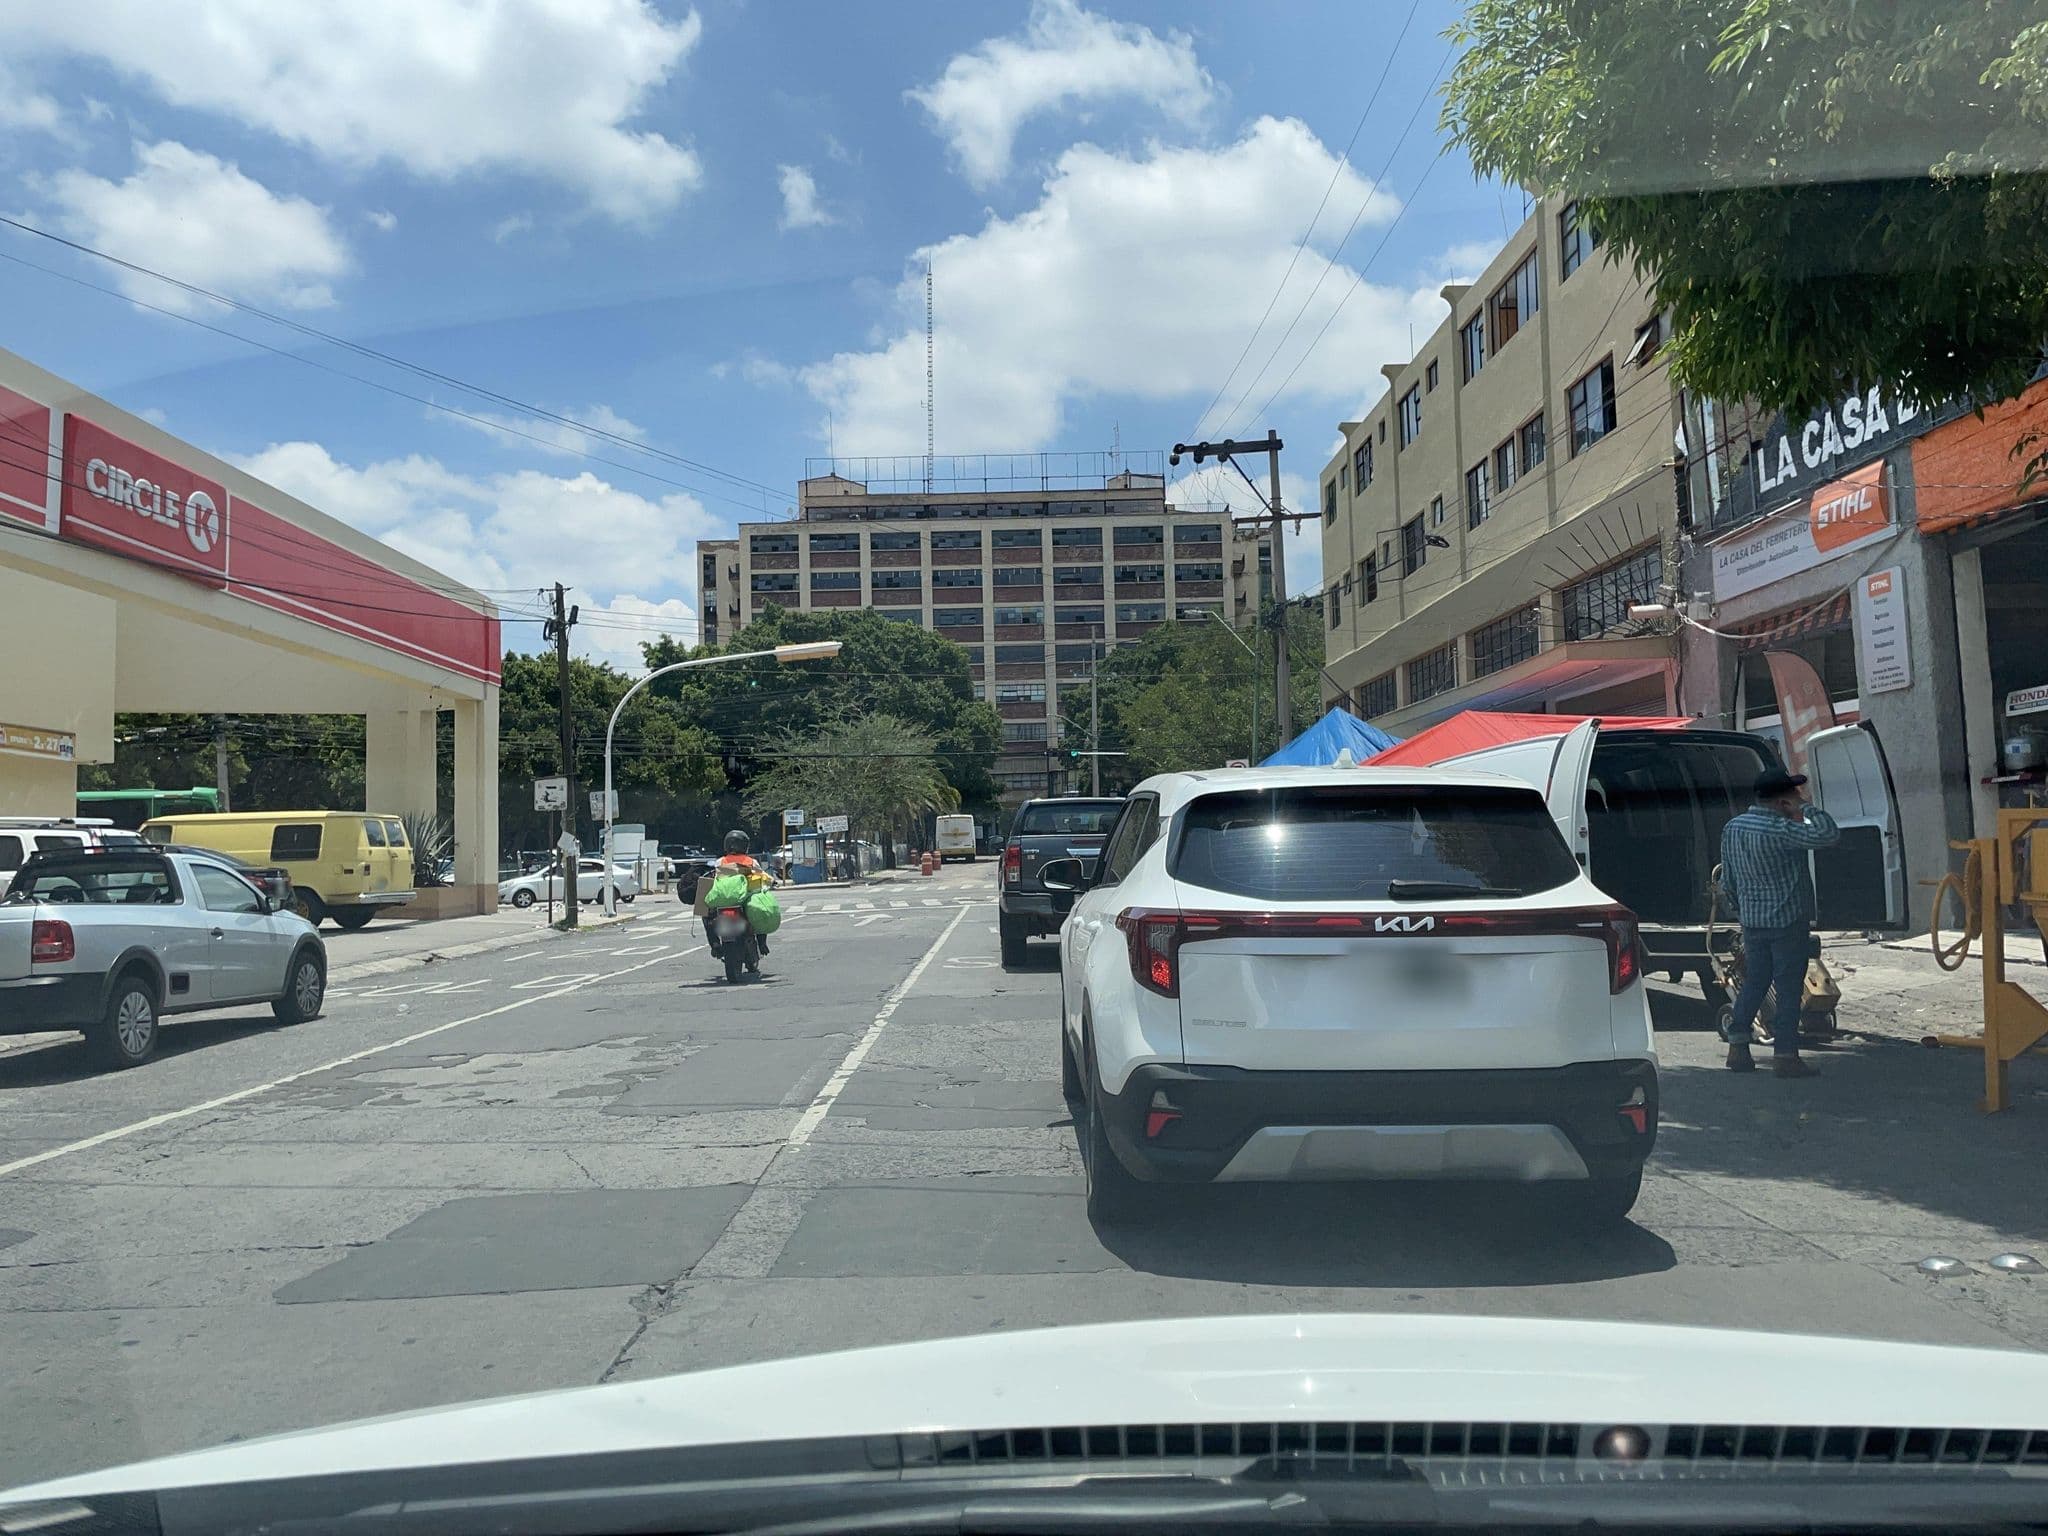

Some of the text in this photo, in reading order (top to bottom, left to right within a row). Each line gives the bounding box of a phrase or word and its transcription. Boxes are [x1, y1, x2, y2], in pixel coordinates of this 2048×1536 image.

[1758, 435, 1797, 493] LA
[1802, 385, 1890, 469] CASA
[86, 458, 219, 552] CIRCLE K
[1818, 486, 1872, 530] STIHL
[1719, 522, 1809, 568] LA CASA DEL FERRETERO
[1374, 916, 1434, 932] KIA
